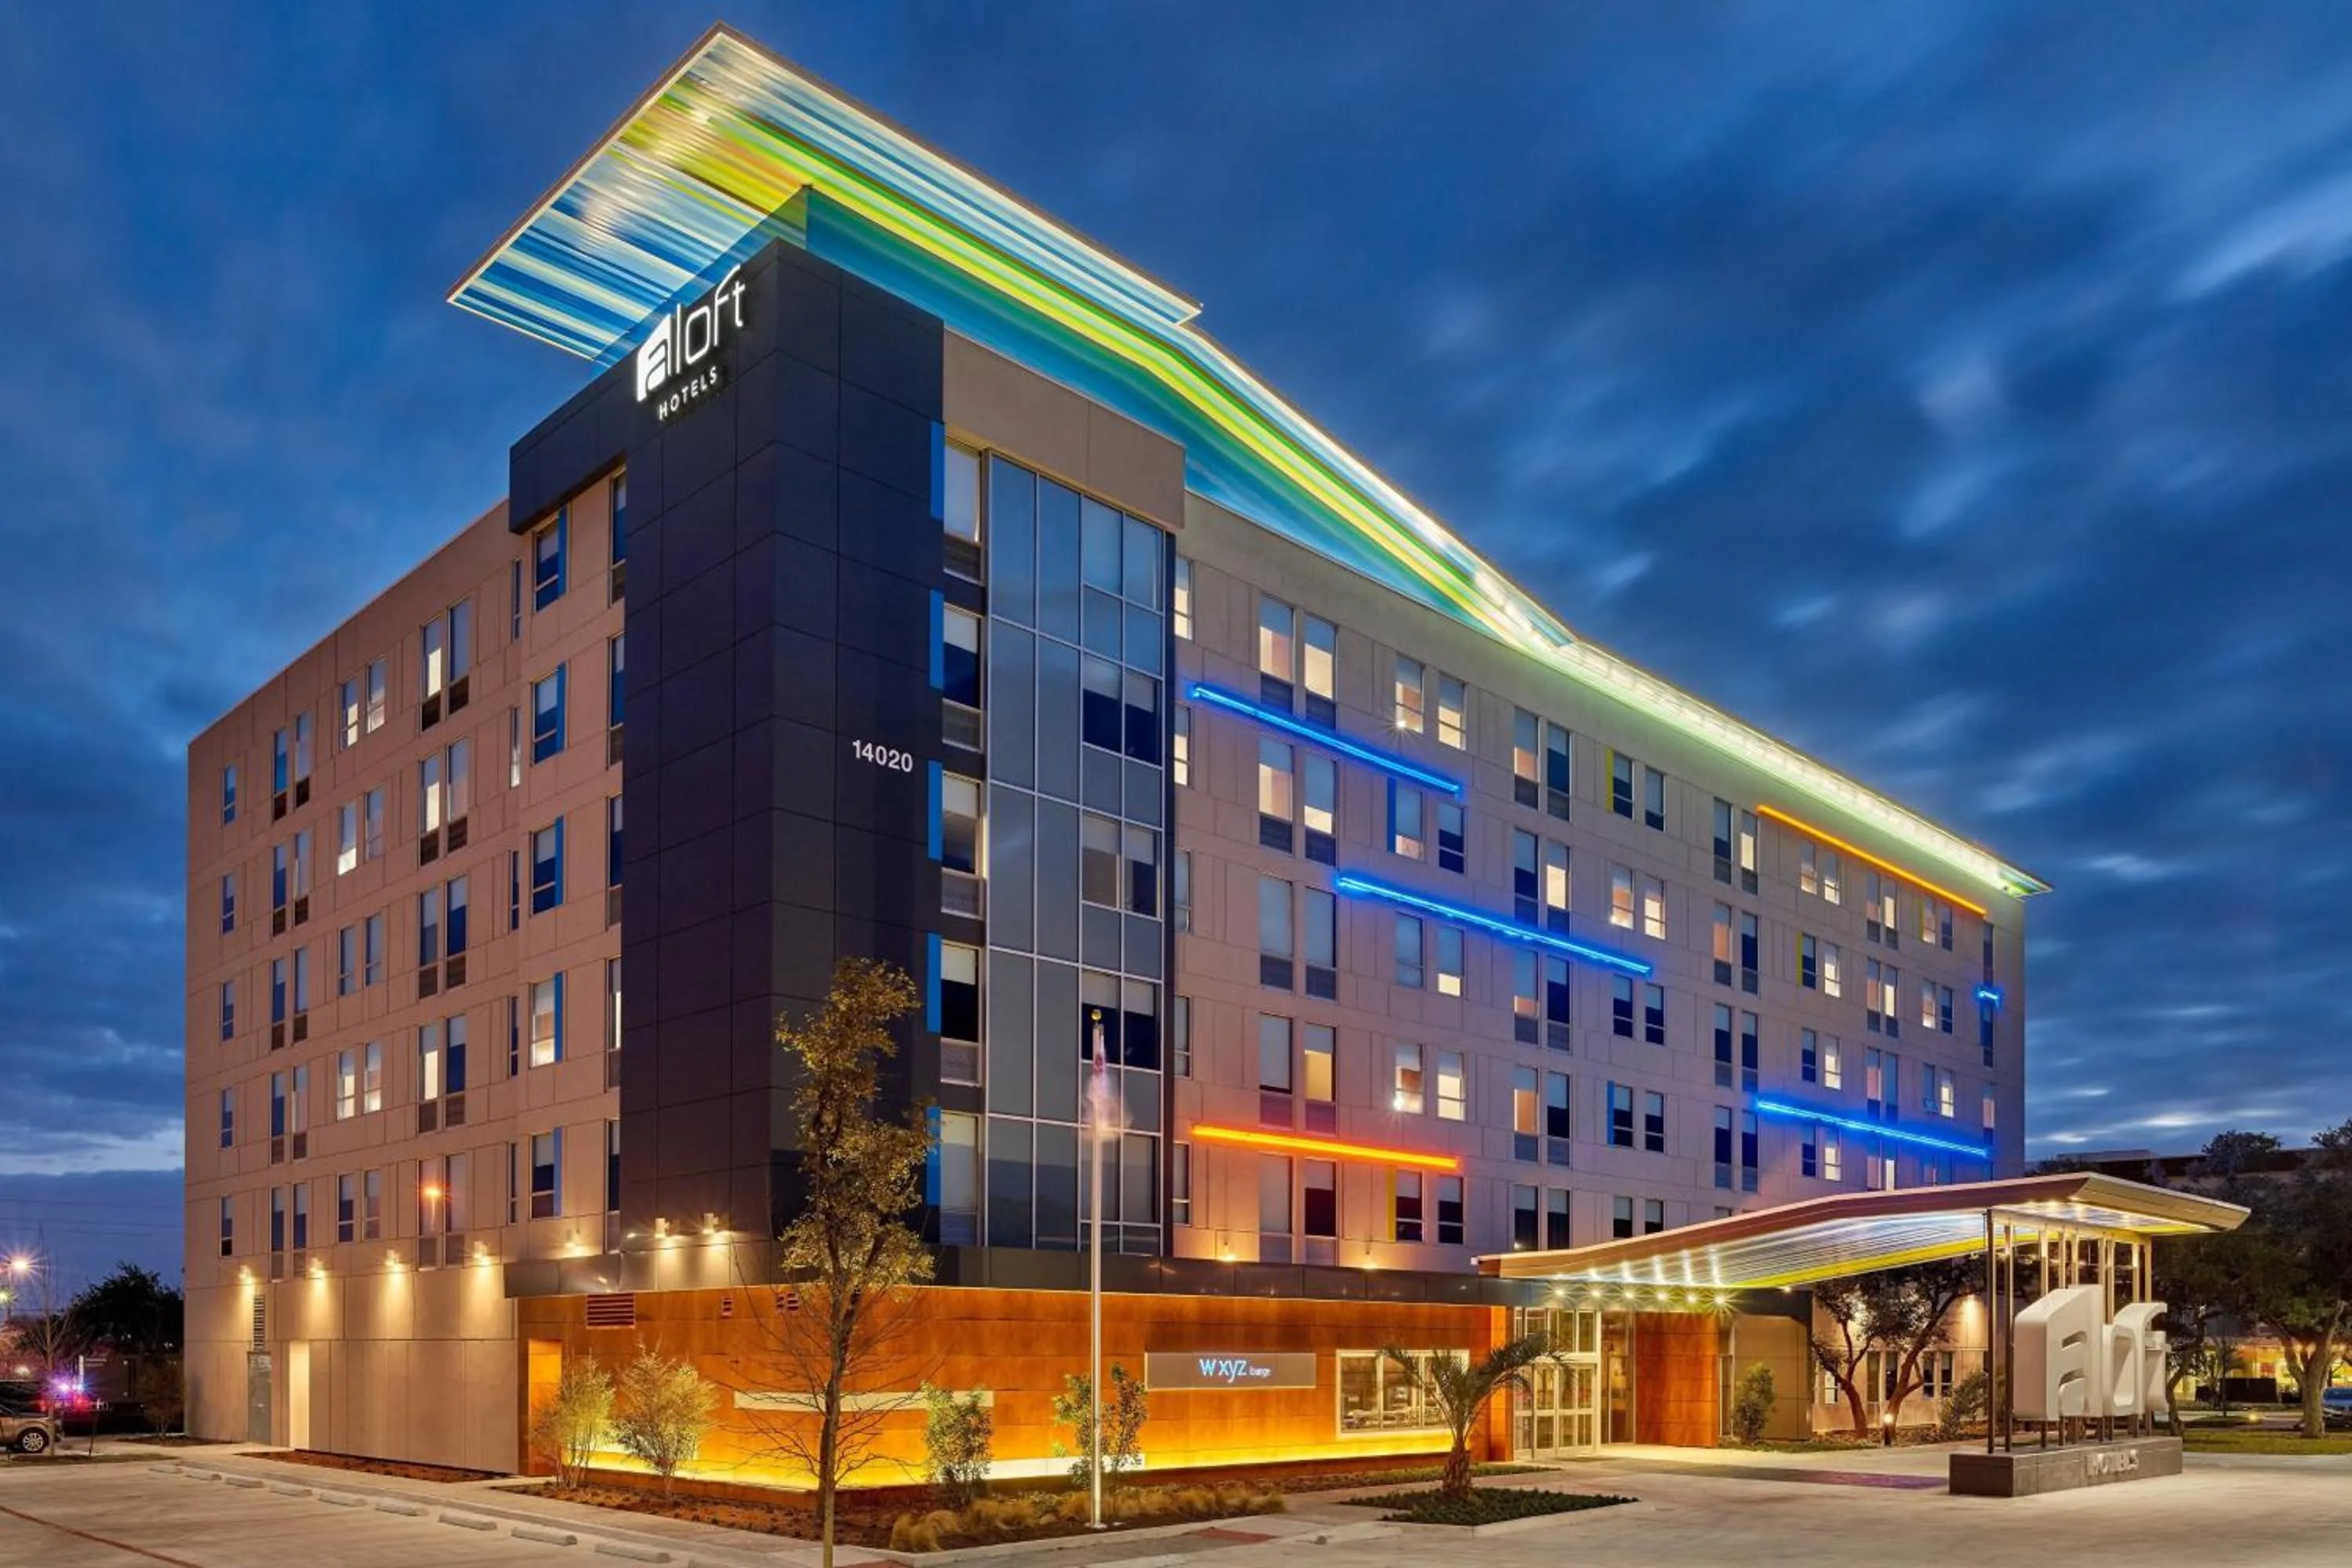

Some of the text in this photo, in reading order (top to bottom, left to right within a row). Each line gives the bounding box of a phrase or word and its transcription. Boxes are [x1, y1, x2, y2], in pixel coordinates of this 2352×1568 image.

[636, 263, 746, 402] aloft
[659, 365, 718, 421] HOTELS
[852, 739, 913, 772] 14020
